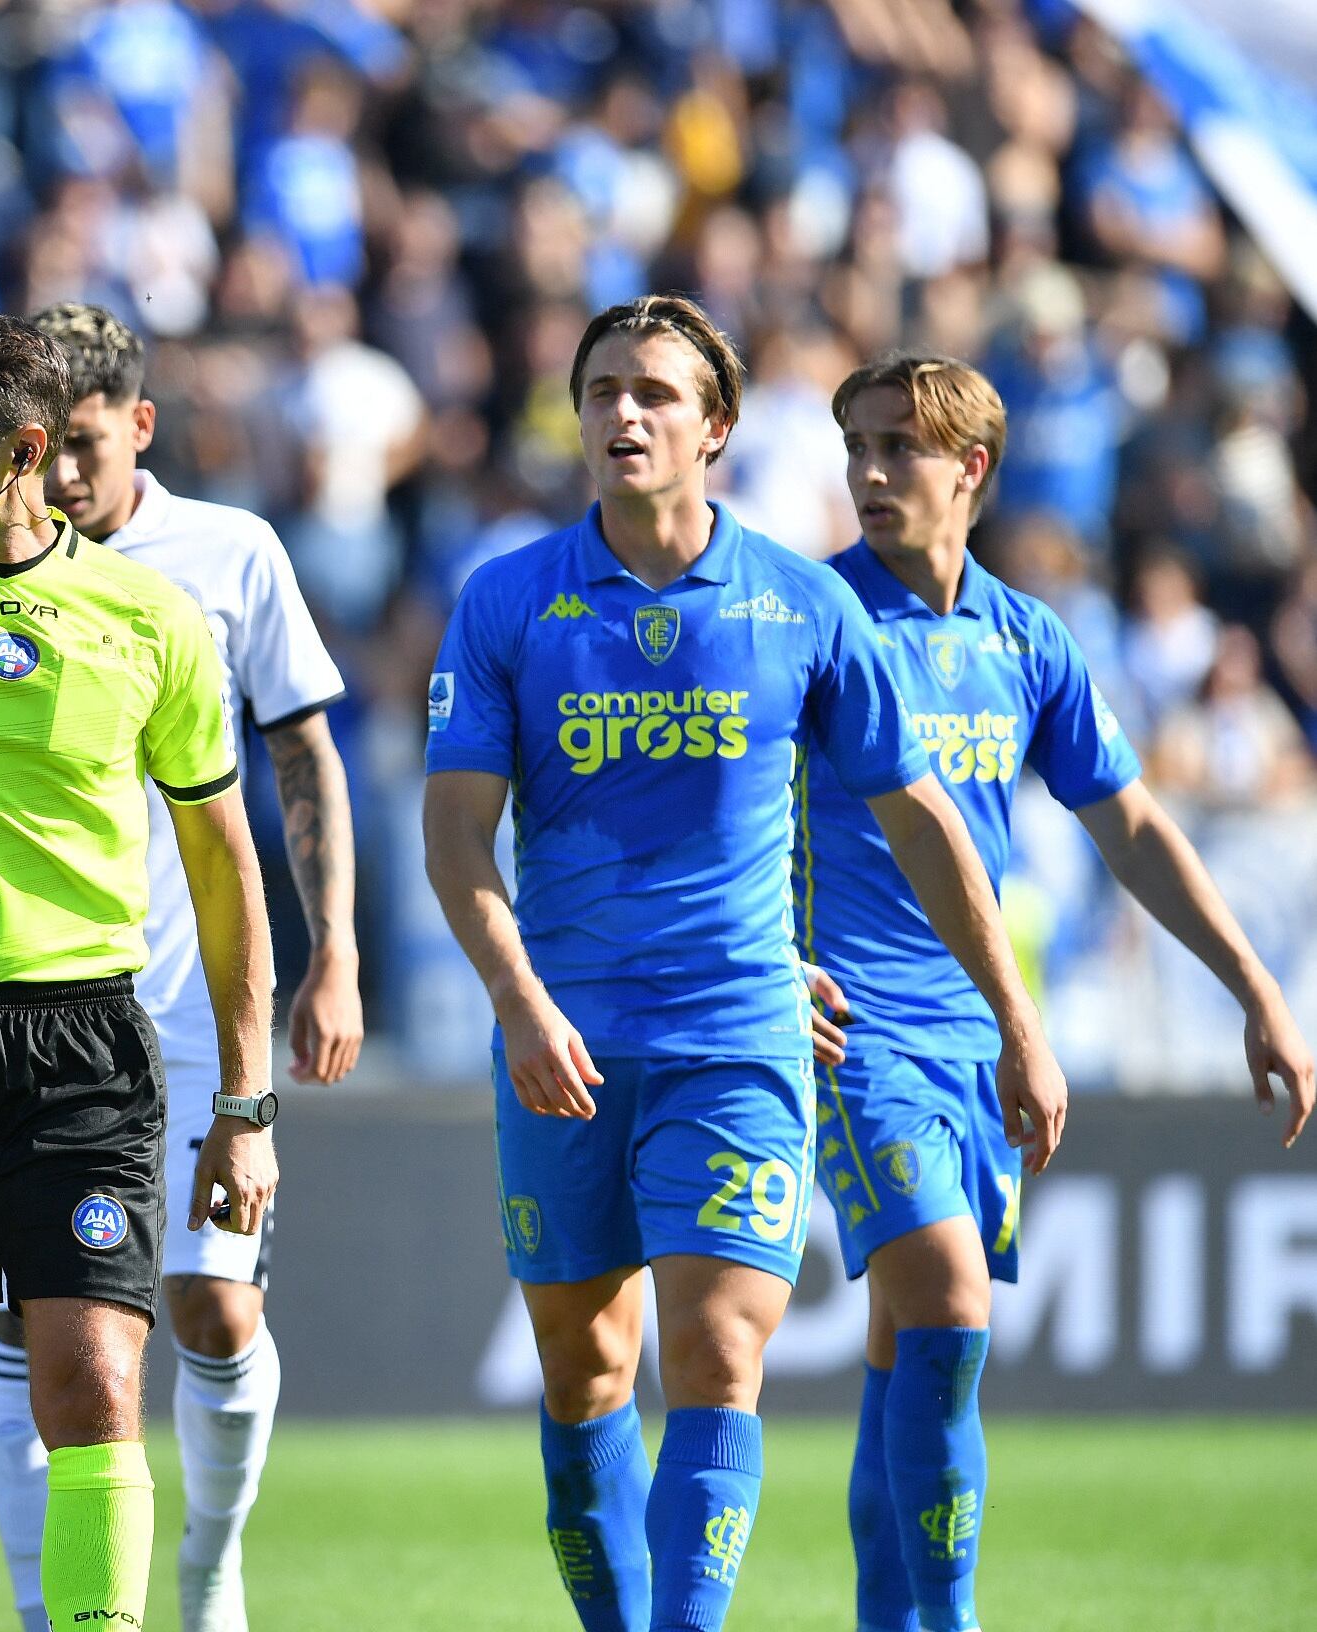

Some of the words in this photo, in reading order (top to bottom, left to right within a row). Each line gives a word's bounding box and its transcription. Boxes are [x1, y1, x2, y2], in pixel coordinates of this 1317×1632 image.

[557, 685, 749, 717] computer
[911, 708, 1018, 741] mputer
[558, 714, 750, 775] gross
[696, 1151, 798, 1242] 29
[82, 1208, 117, 1231] AIA
[74, 1609, 142, 1629] GIVOV
